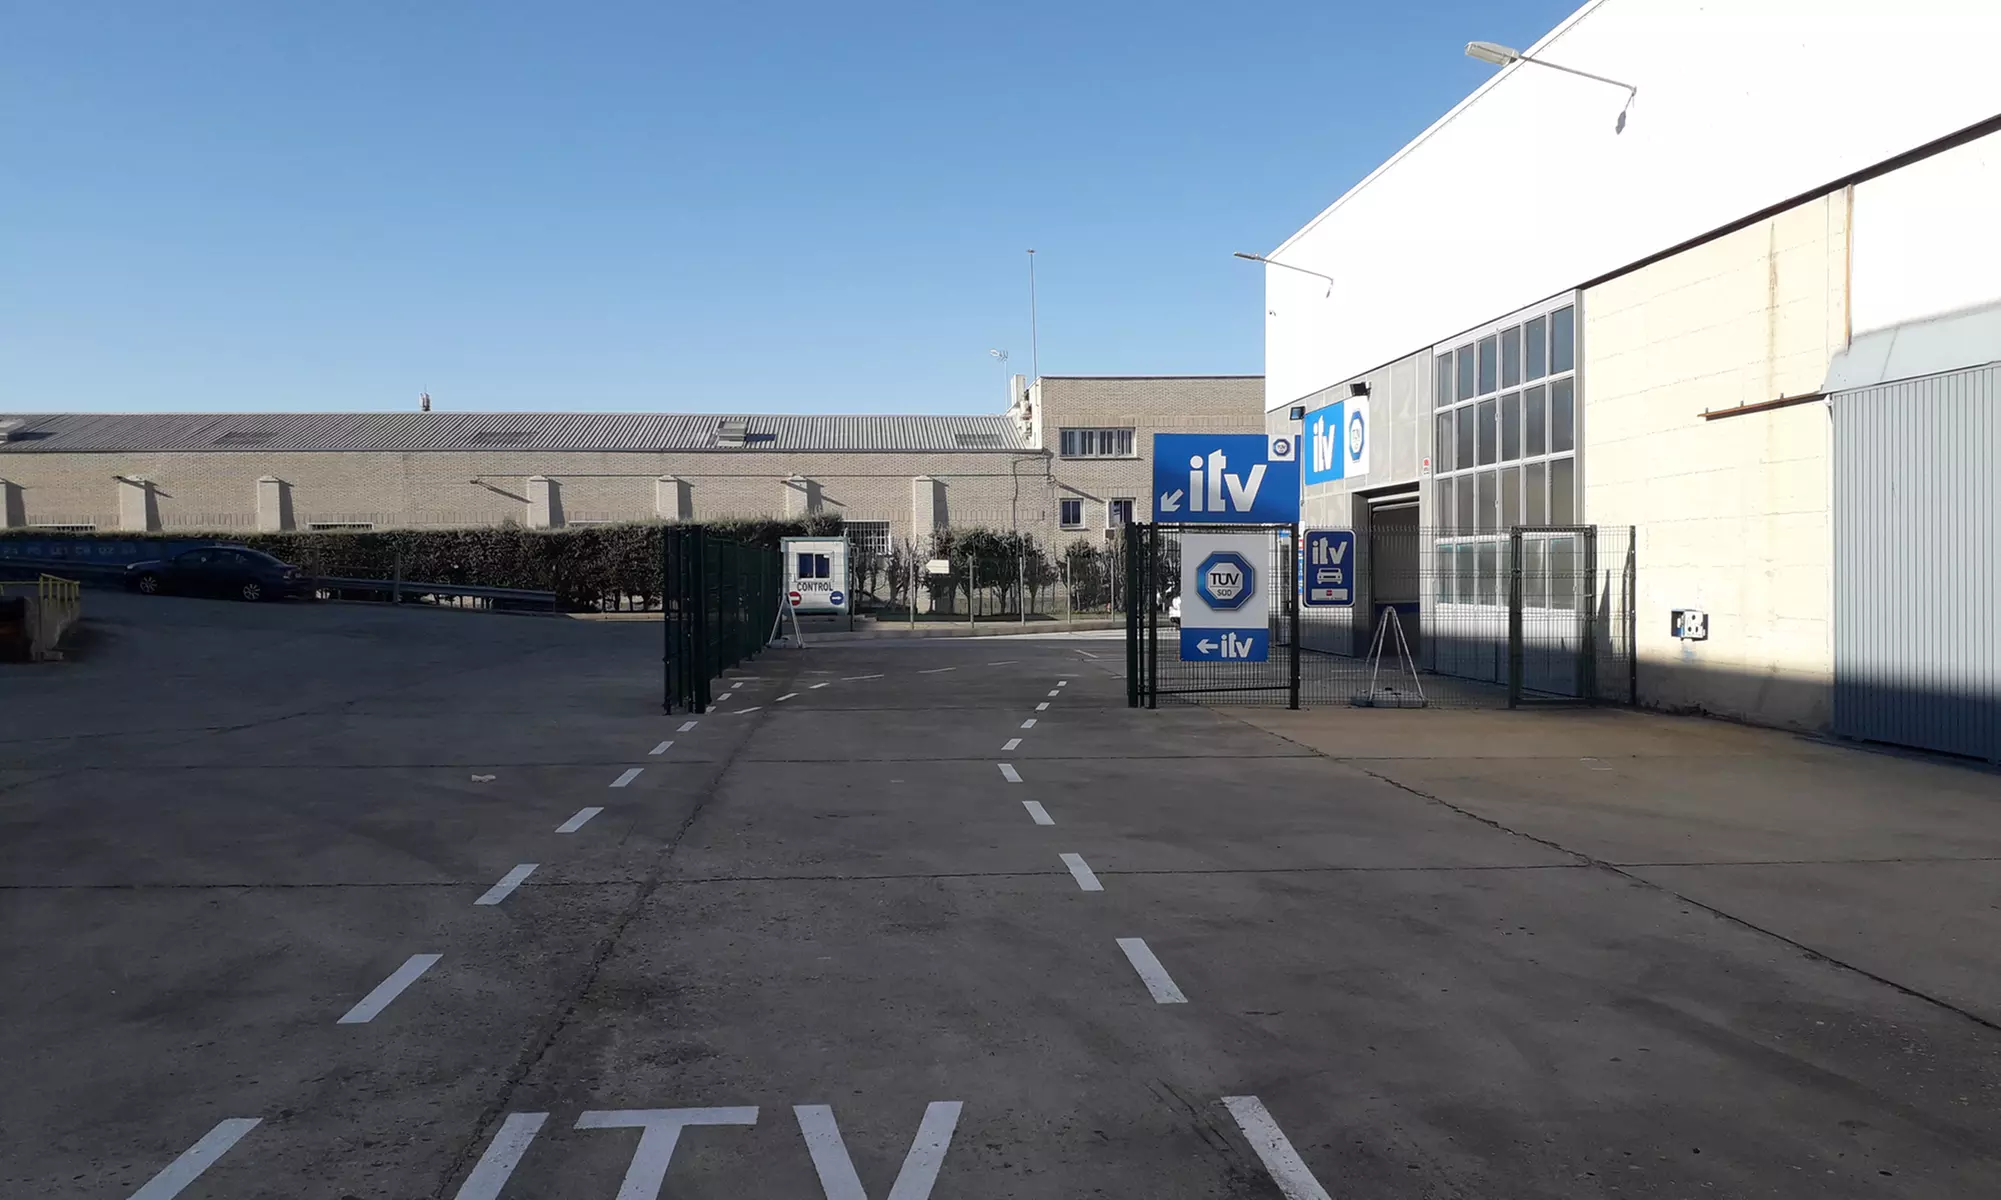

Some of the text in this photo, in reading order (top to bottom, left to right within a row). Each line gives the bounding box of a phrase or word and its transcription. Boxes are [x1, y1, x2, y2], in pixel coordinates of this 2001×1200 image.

[1313, 414, 1336, 473] itv
[1189, 448, 1268, 512] itv
[1312, 536, 1348, 565] itv
[796, 582, 833, 592] CONTROL
[1209, 572, 1240, 586] TÜV
[1220, 631, 1253, 659] itv
